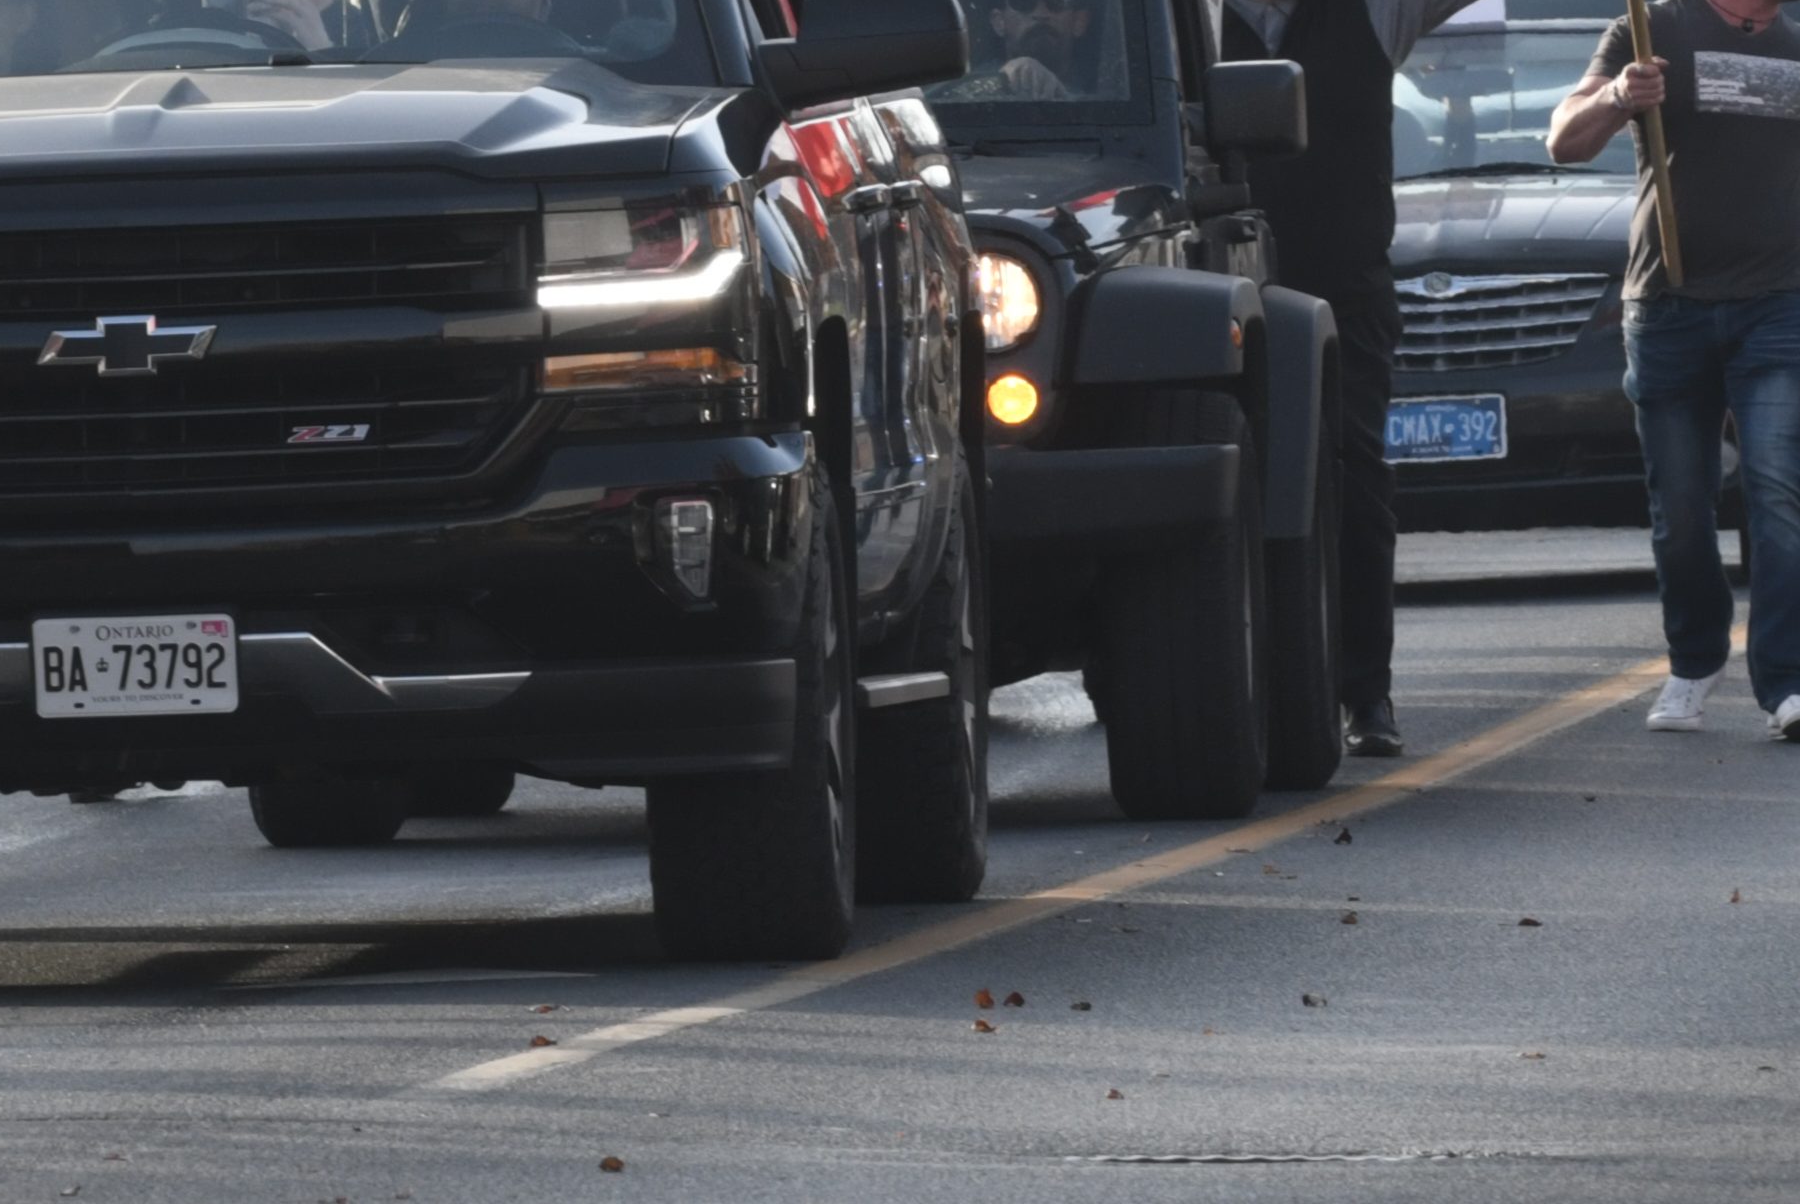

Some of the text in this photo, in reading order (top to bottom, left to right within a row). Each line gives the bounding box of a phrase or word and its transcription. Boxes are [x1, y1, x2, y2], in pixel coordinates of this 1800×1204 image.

[286, 423, 371, 444] Z71
[1388, 410, 1498, 446] CMAX 392
[95, 624, 175, 642] ONTARIO
[43, 642, 228, 693] BA 73792
